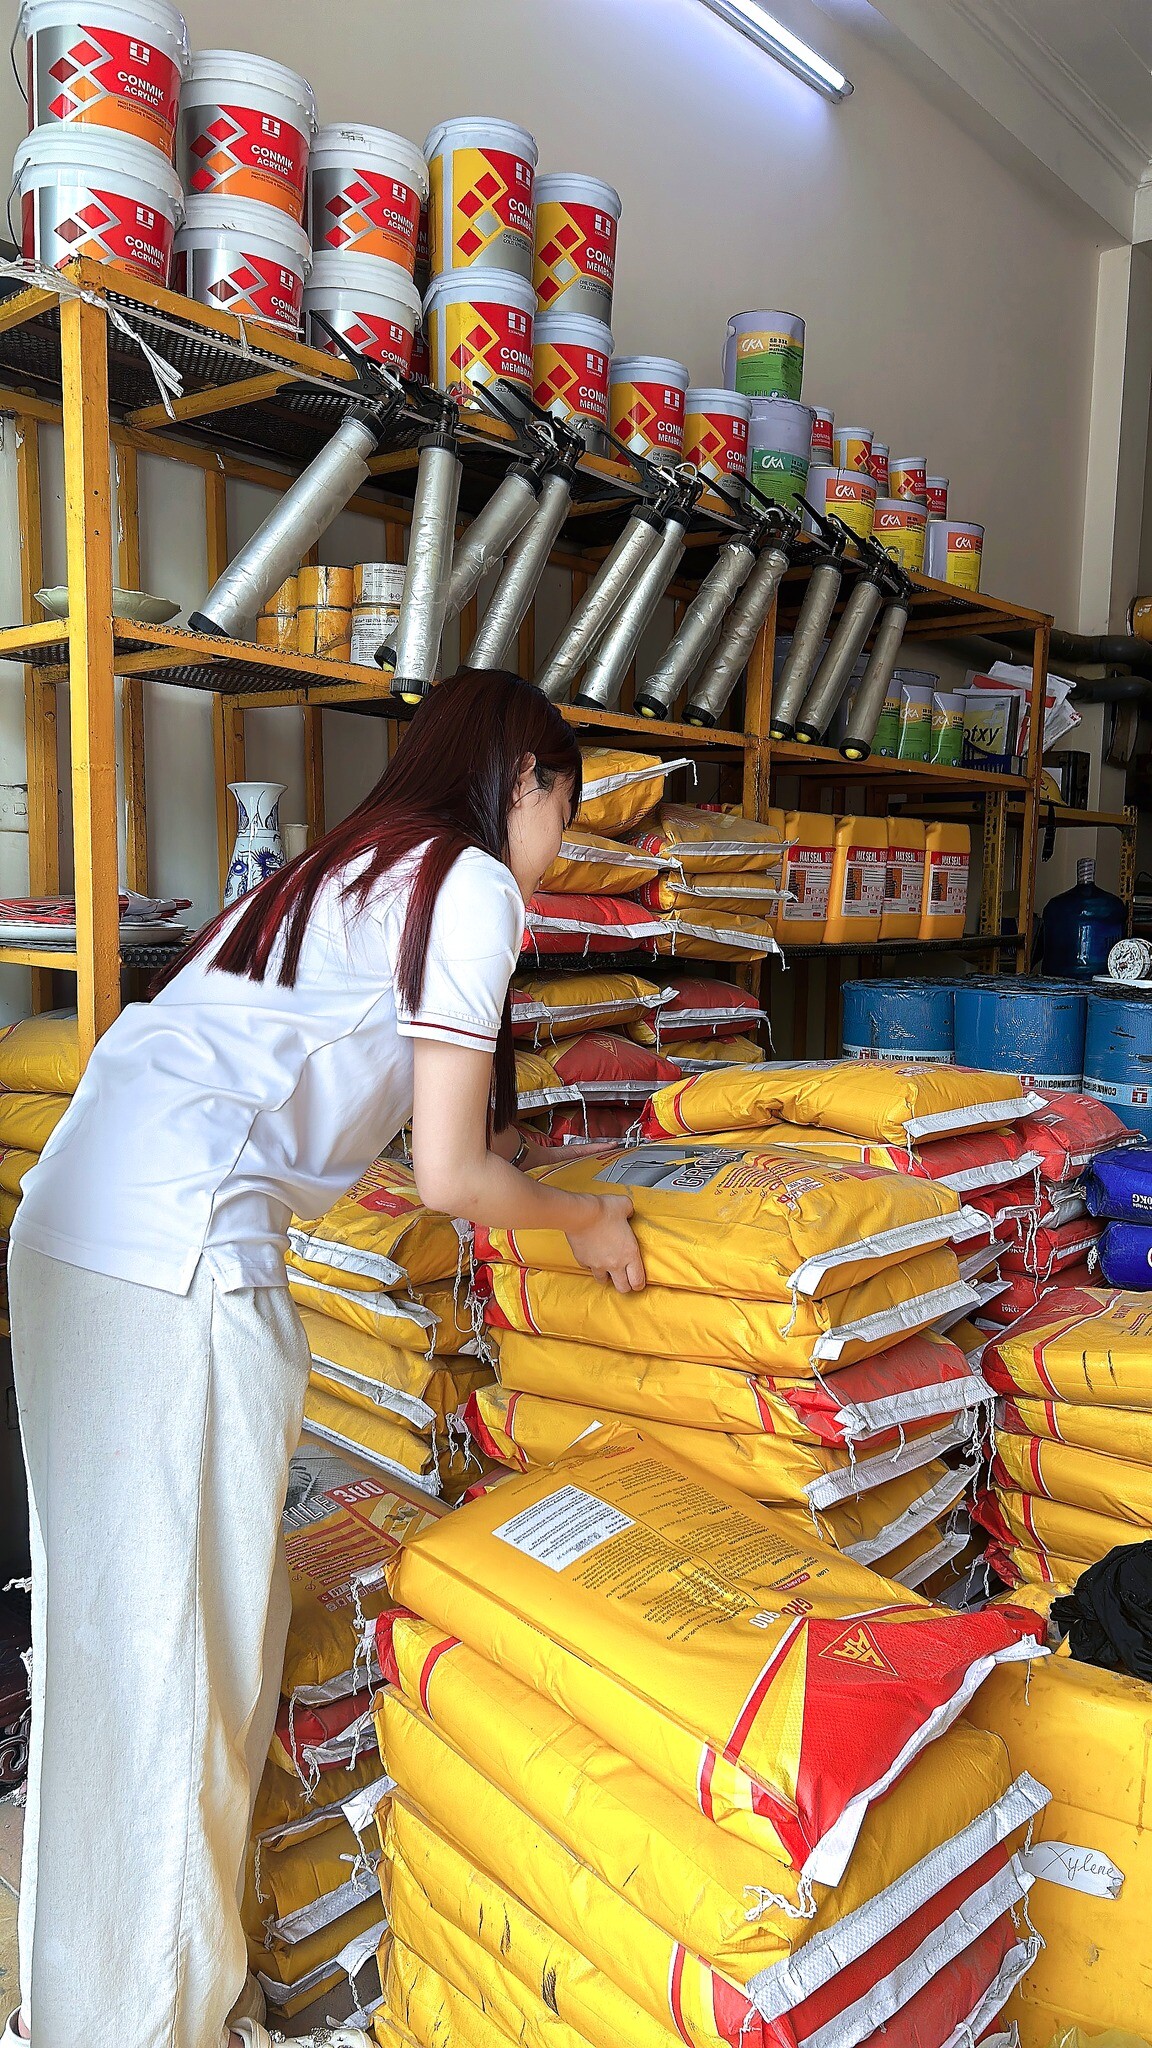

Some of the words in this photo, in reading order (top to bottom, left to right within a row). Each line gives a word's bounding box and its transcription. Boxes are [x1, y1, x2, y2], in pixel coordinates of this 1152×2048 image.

[117, 71, 164, 100] CONMIK
[124, 85, 159, 106] ACRYLIC
[250, 144, 294, 170] CONMIK
[256, 157, 289, 175] ACRYLIC
[383, 208, 414, 232] CONMIK
[388, 220, 411, 237] ACRYLIC
[124, 235, 165, 262] CONMIK
[131, 249, 162, 268] ACRYLIC
[742, 338, 764, 352] CKA
[762, 456, 784, 470] CKA
[836, 485, 856, 498] CKA
[880, 514, 900, 526] CKA
[956, 537, 972, 548] CKA
[282, 1494, 338, 1527] TILE
[749, 1610, 780, 1628] 900
[1042, 1846, 1115, 1880] Xylene
